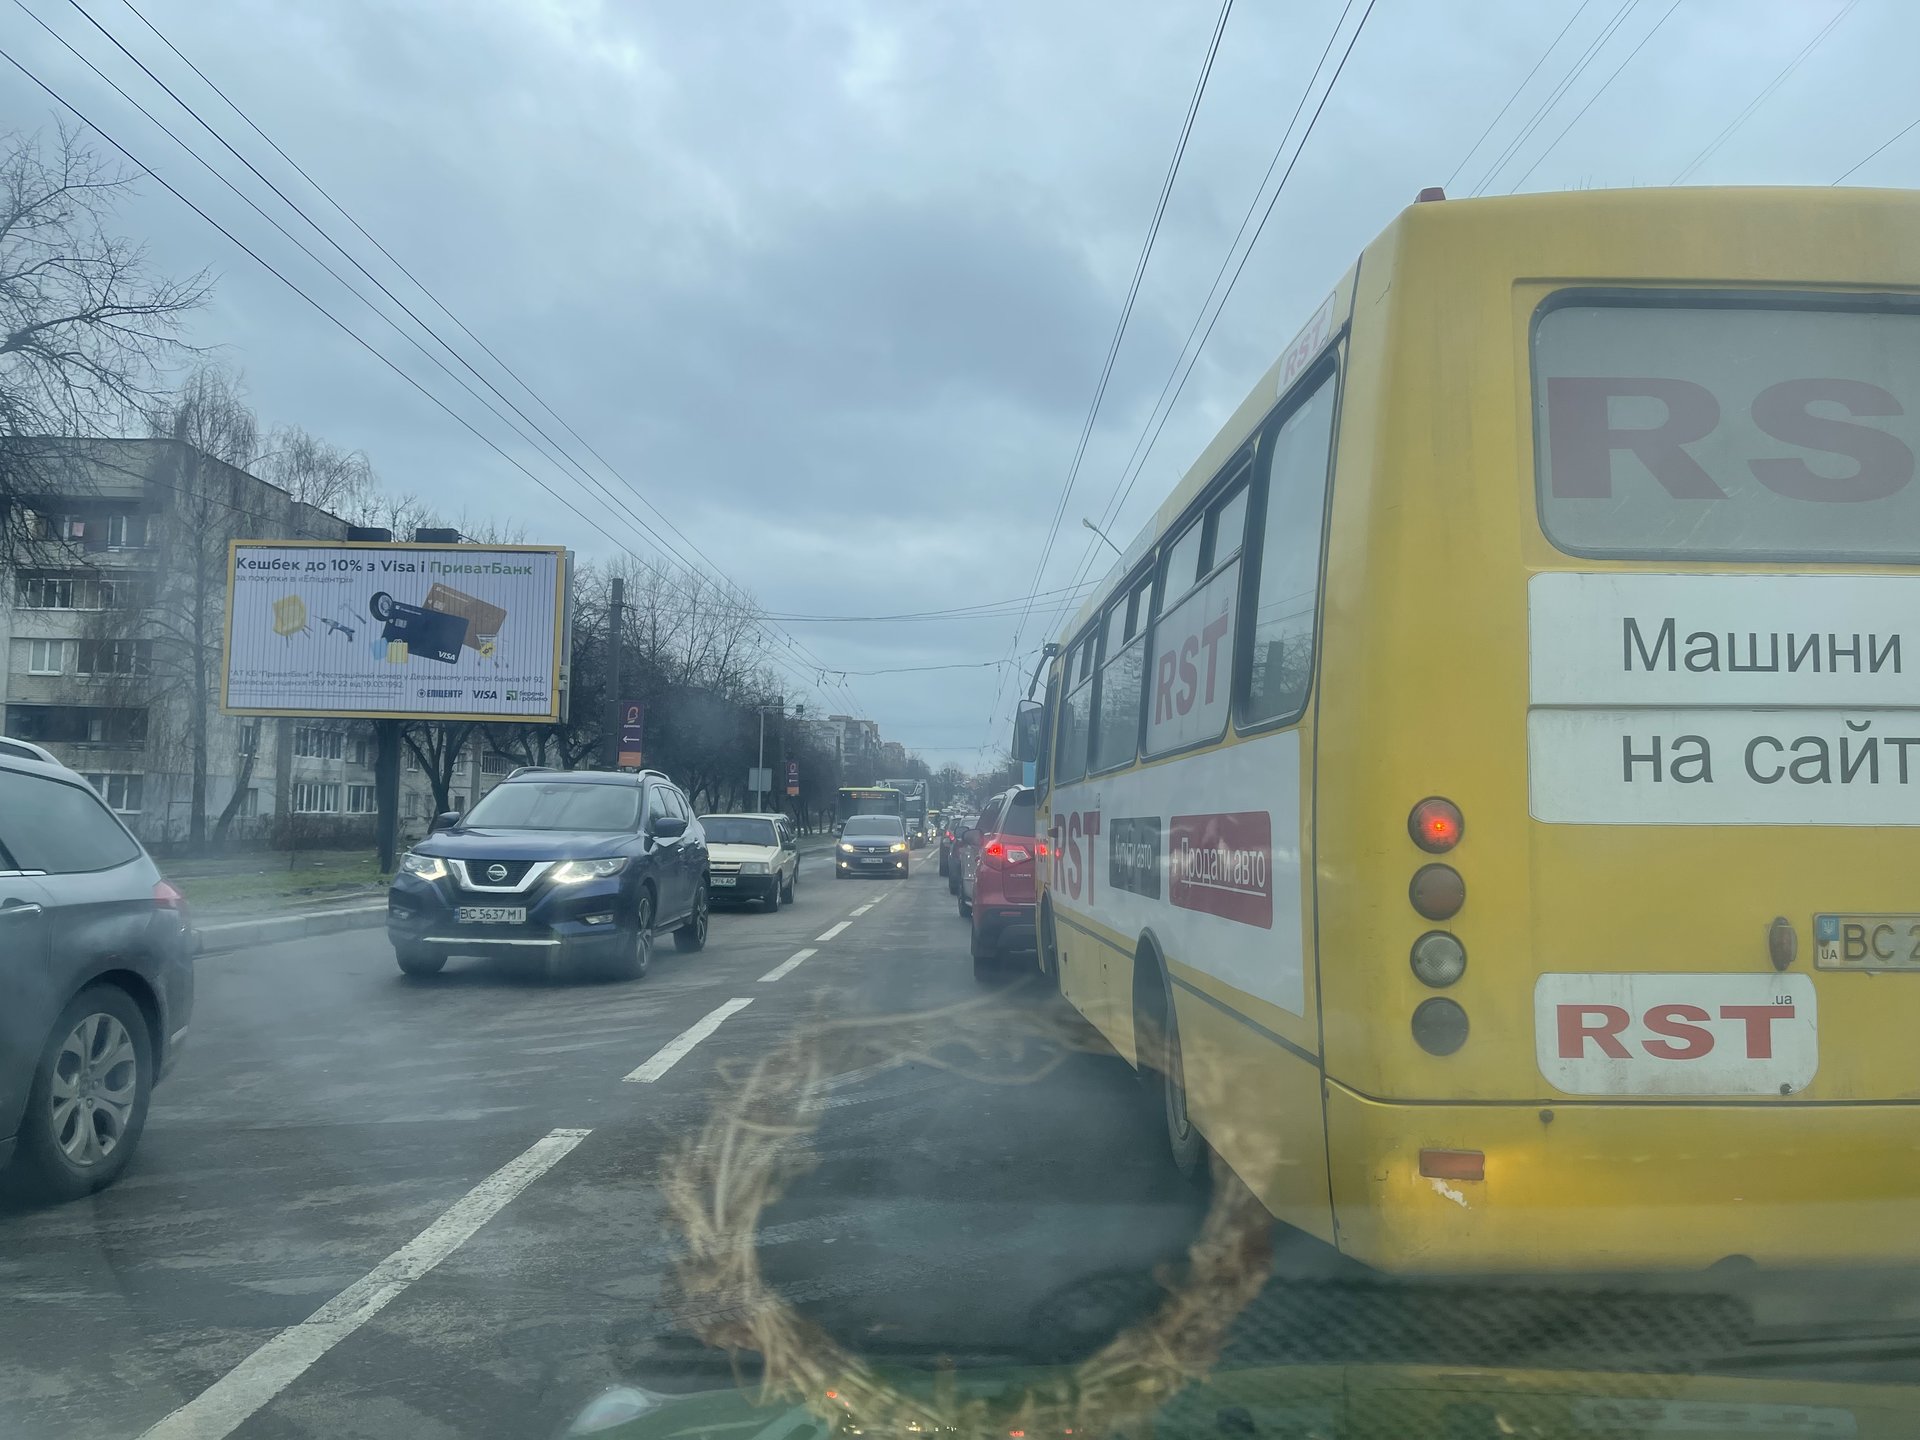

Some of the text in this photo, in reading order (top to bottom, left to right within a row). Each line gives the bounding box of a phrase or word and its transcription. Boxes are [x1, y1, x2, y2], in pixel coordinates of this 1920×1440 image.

[1283, 307, 1327, 385] RST
[236, 557, 533, 576] Кешбек до 10% з Visa і ПриватБанк
[248, 575, 288, 584] покупки
[438, 650, 456, 661] VISA
[1623, 617, 1902, 674] Машини
[1155, 612, 1229, 725] RST
[308, 679, 325, 687] НБУ
[426, 689, 463, 698] ЕПІЦЕНТР
[472, 690, 498, 699] VISA
[1622, 719, 1920, 785] на сайт
[1053, 810, 1100, 906] RST
[1137, 843, 1152, 870] авто
[1181, 837, 1231, 888] Продати
[1233, 849, 1266, 888] авто
[460, 908, 523, 920] BC 5637 MI
[1843, 923, 1896, 961] BC
[1821, 949, 1838, 960] UA
[1771, 993, 1793, 1006] .ua
[1556, 1003, 1795, 1060] RST
